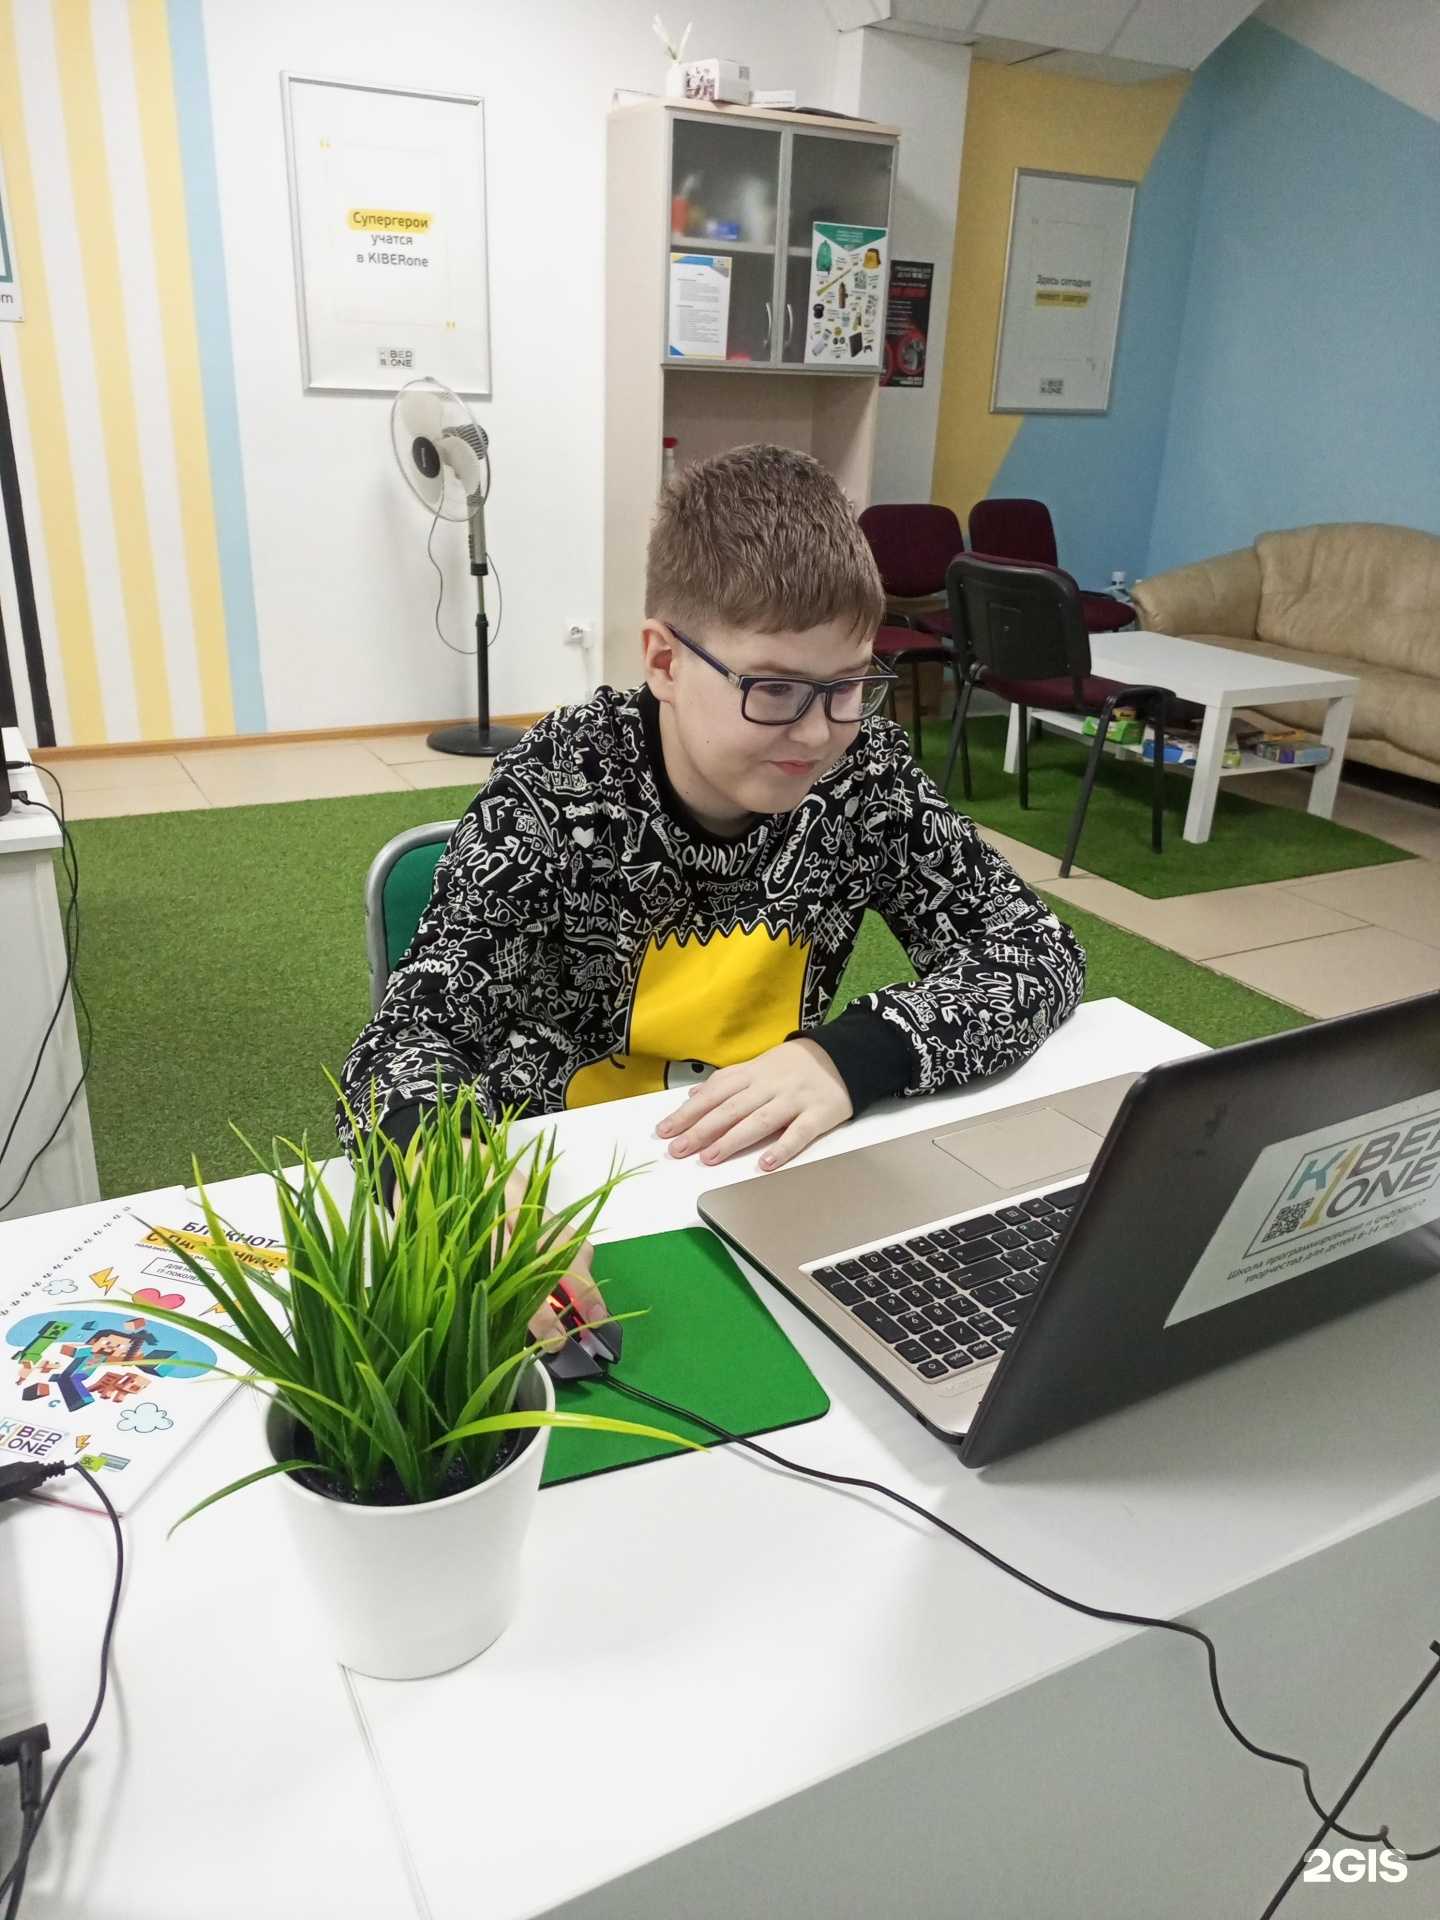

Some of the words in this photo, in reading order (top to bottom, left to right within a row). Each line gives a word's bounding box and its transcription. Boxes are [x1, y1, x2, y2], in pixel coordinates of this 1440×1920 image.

[352, 211, 429, 228] Супергерои
[371, 234, 413, 246] учатся
[356, 253, 364, 263] в
[368, 252, 429, 267] KIBERone
[1326, 1150, 1440, 1218] ONE
[182, 1221, 279, 1249] БЛКНОТ
[8, 1437, 52, 1456] ONE
